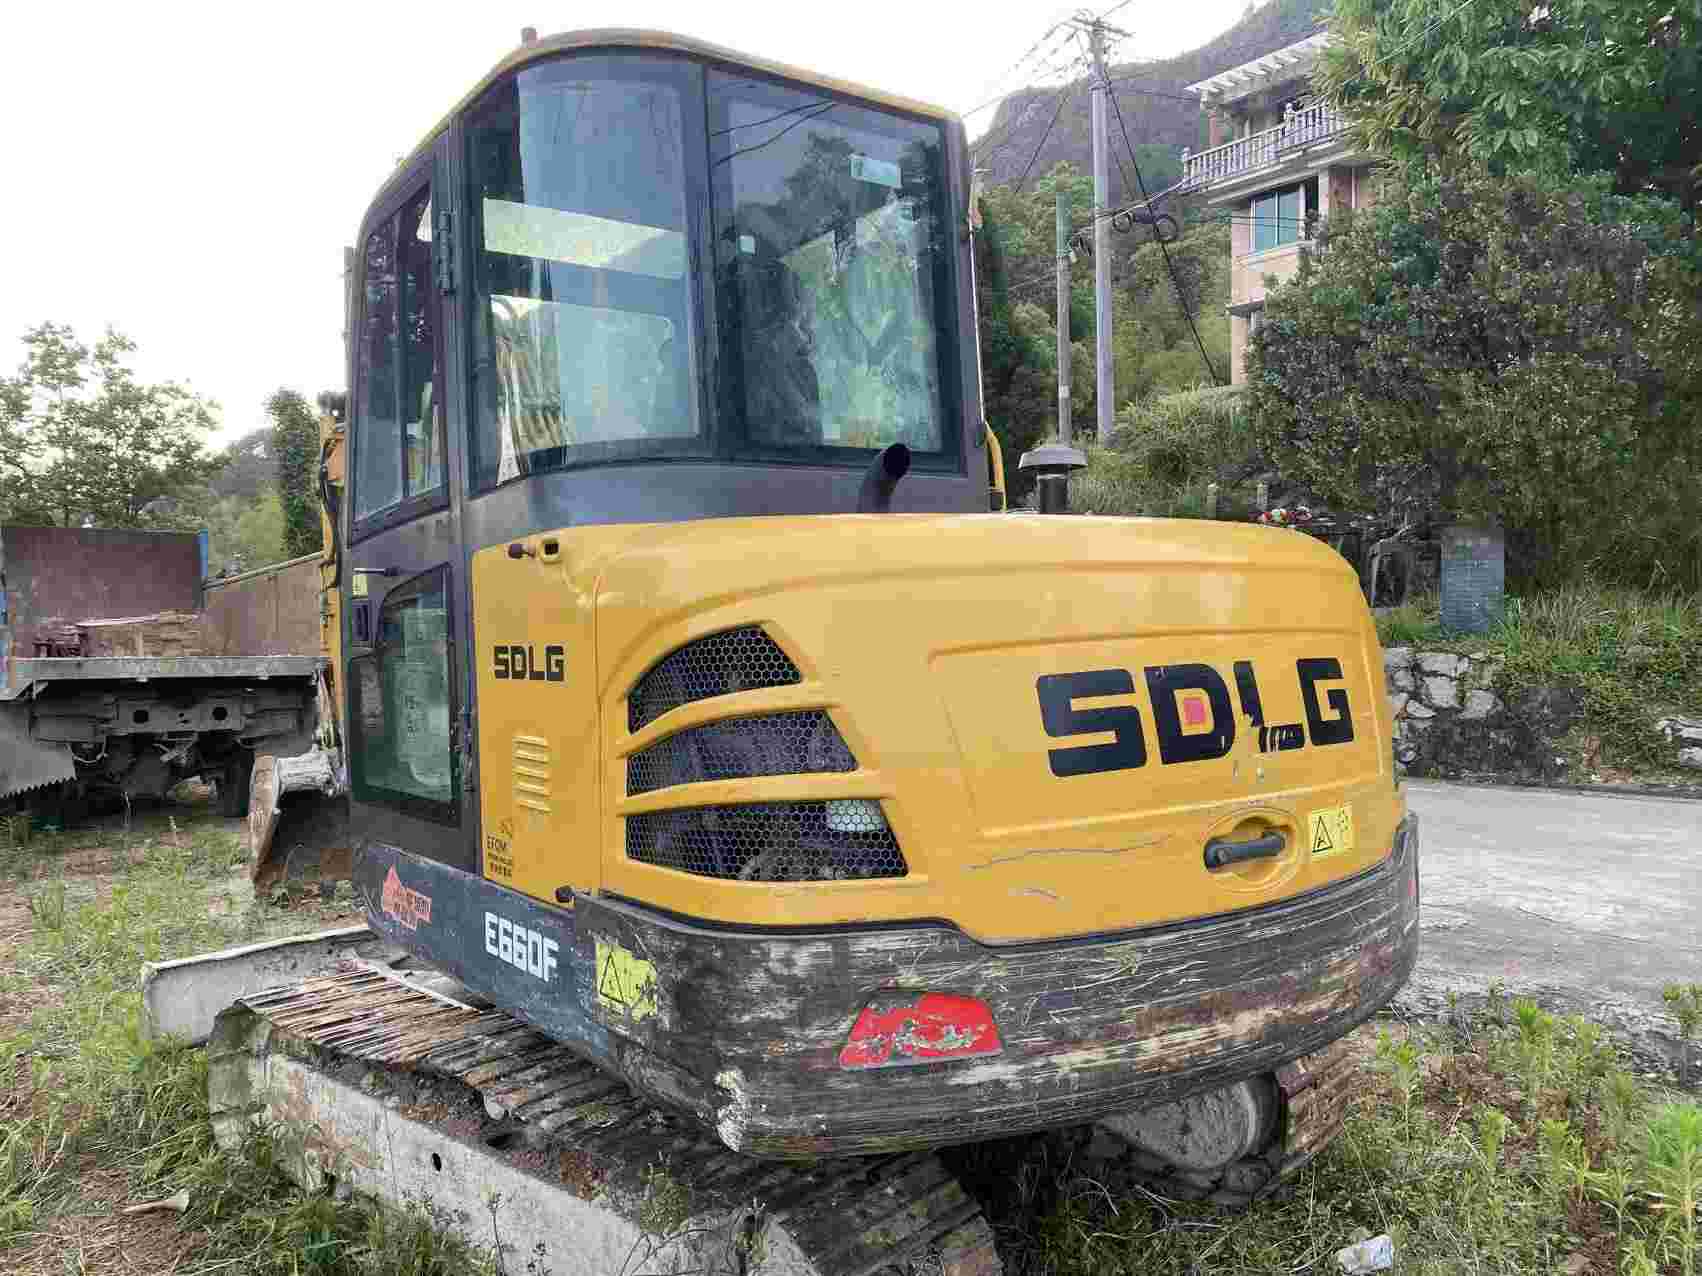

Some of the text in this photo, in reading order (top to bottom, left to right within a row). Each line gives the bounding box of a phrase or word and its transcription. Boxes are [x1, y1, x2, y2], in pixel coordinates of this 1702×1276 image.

[494, 645, 565, 681] SDLG
[1038, 657, 1354, 777] SDLG
[484, 911, 560, 983] E660F
